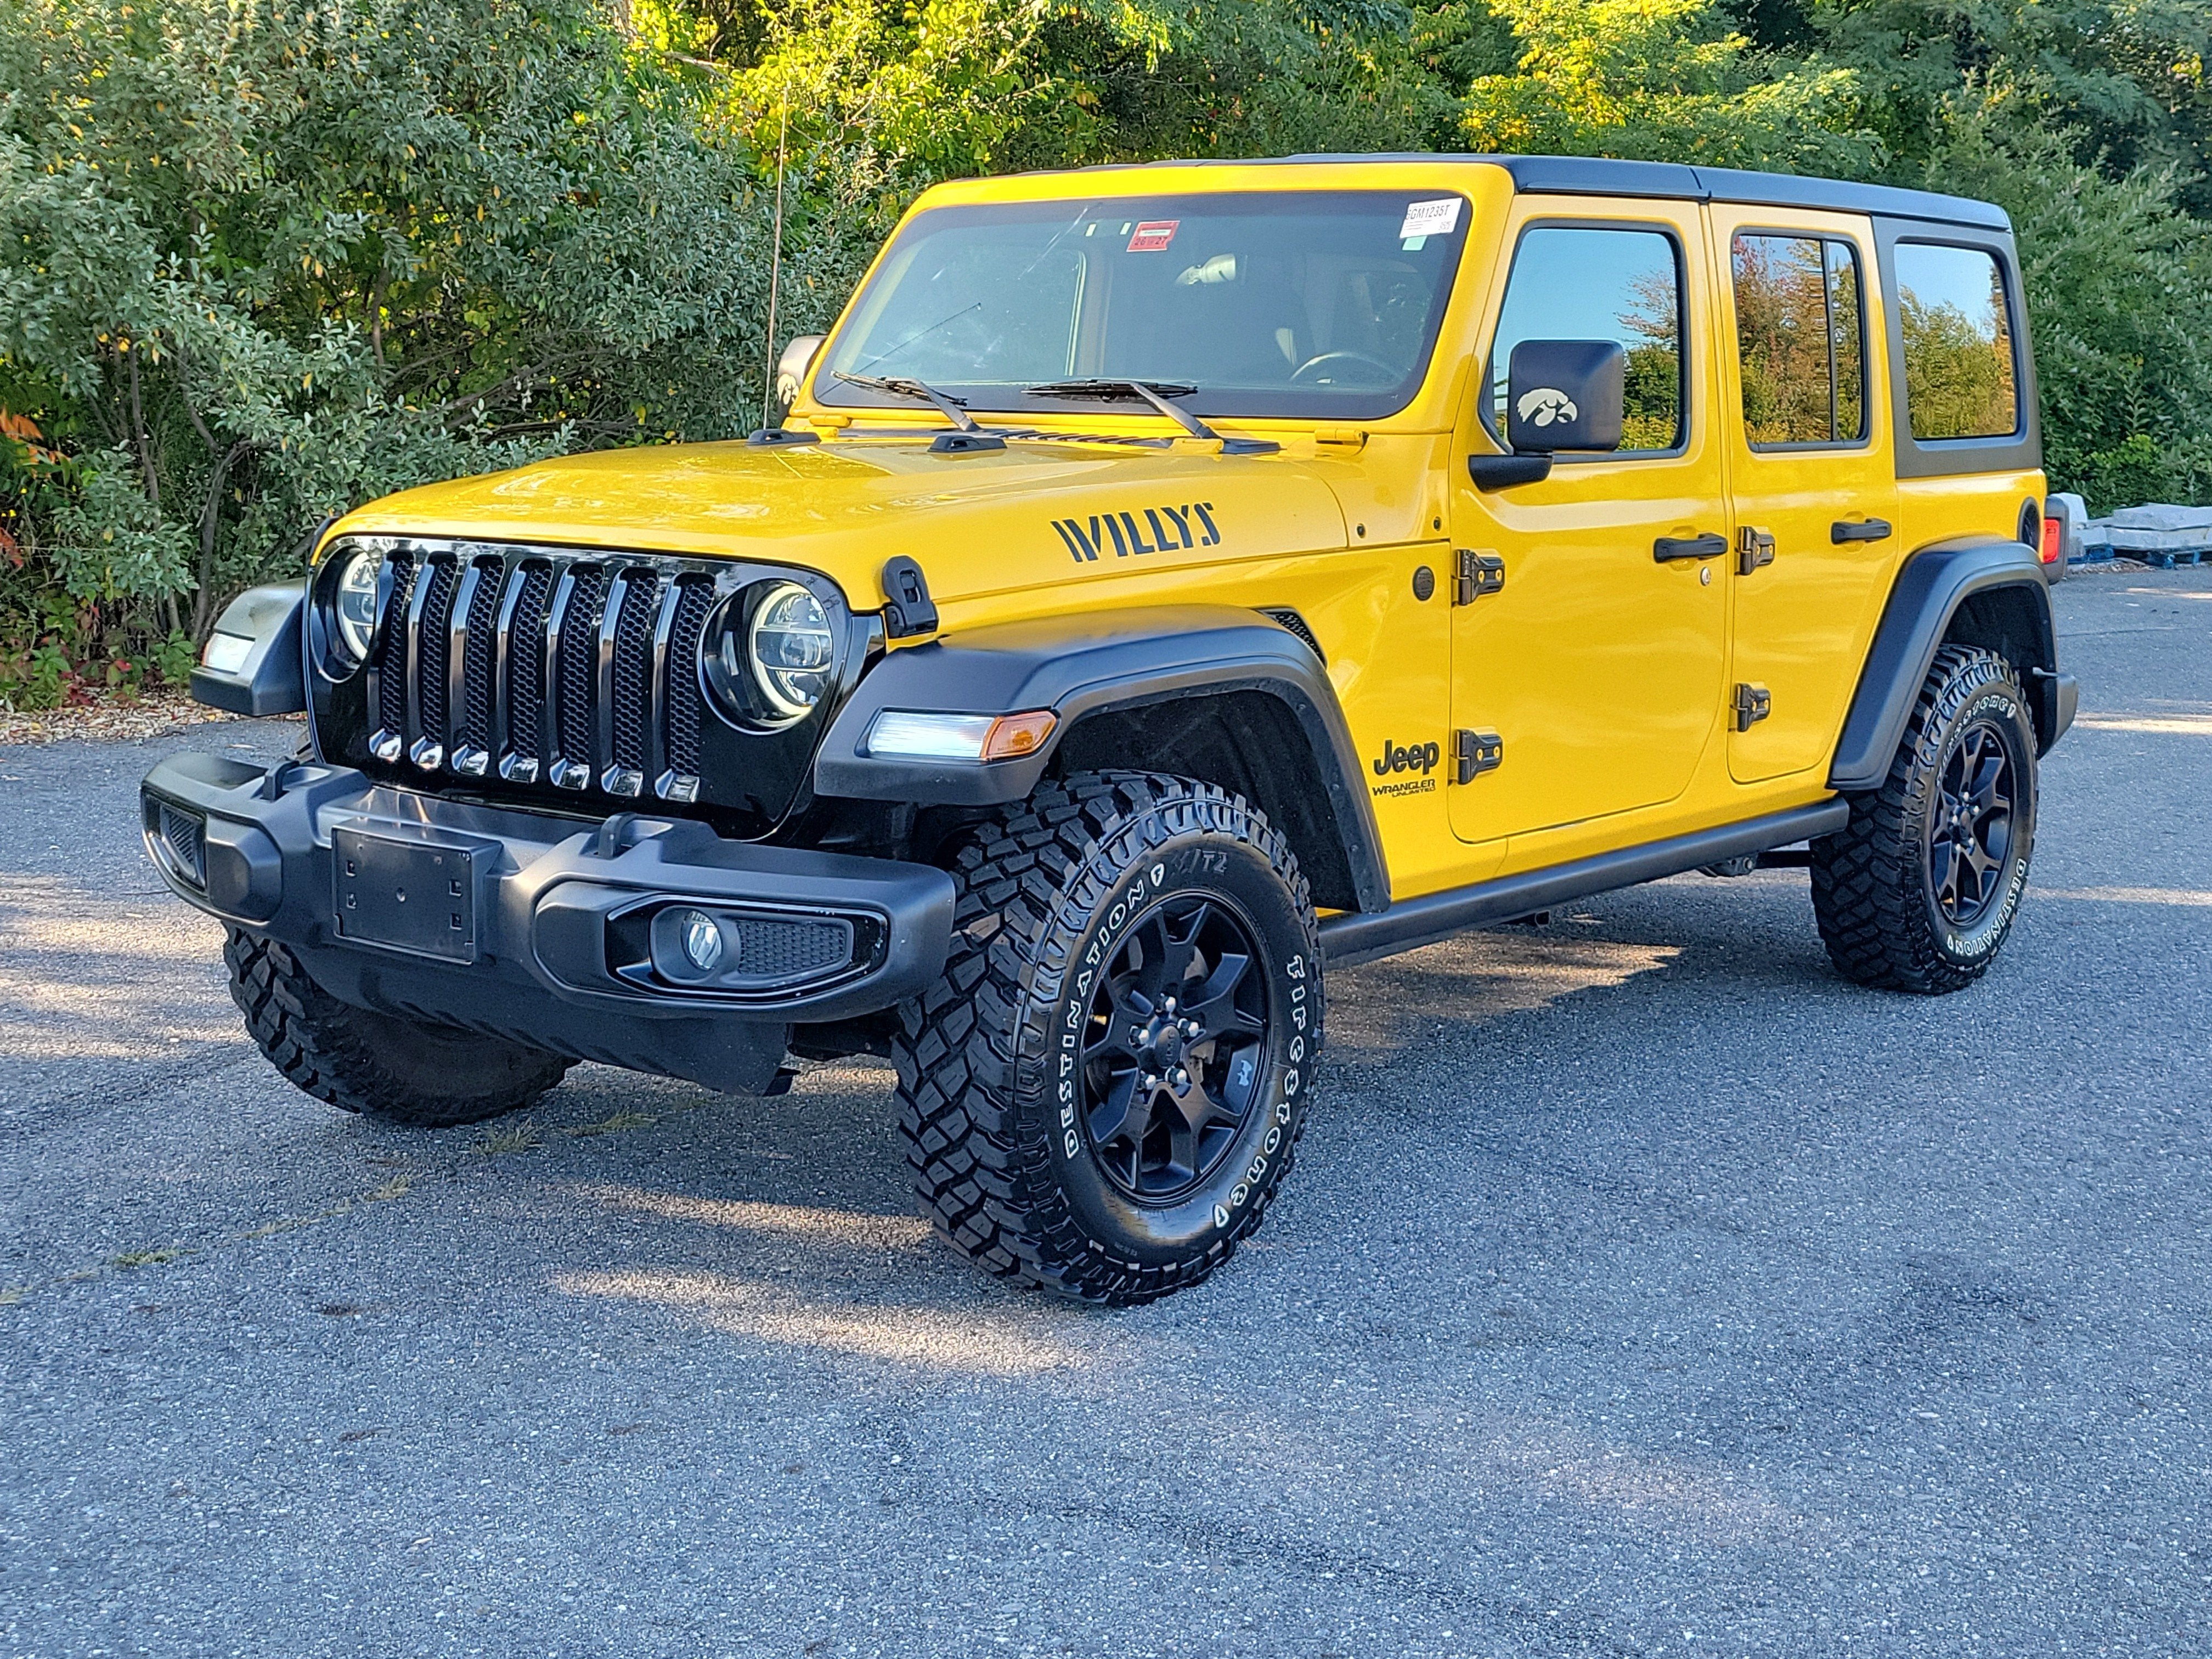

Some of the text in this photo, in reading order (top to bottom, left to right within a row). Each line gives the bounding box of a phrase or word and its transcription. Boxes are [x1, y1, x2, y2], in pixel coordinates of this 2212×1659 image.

[1049, 502, 1221, 563] WILLYS
[1373, 739, 1440, 776] Jeep
[1372, 778, 1436, 796] WRANGLER
[1392, 787, 1436, 798] UNLIMITED
